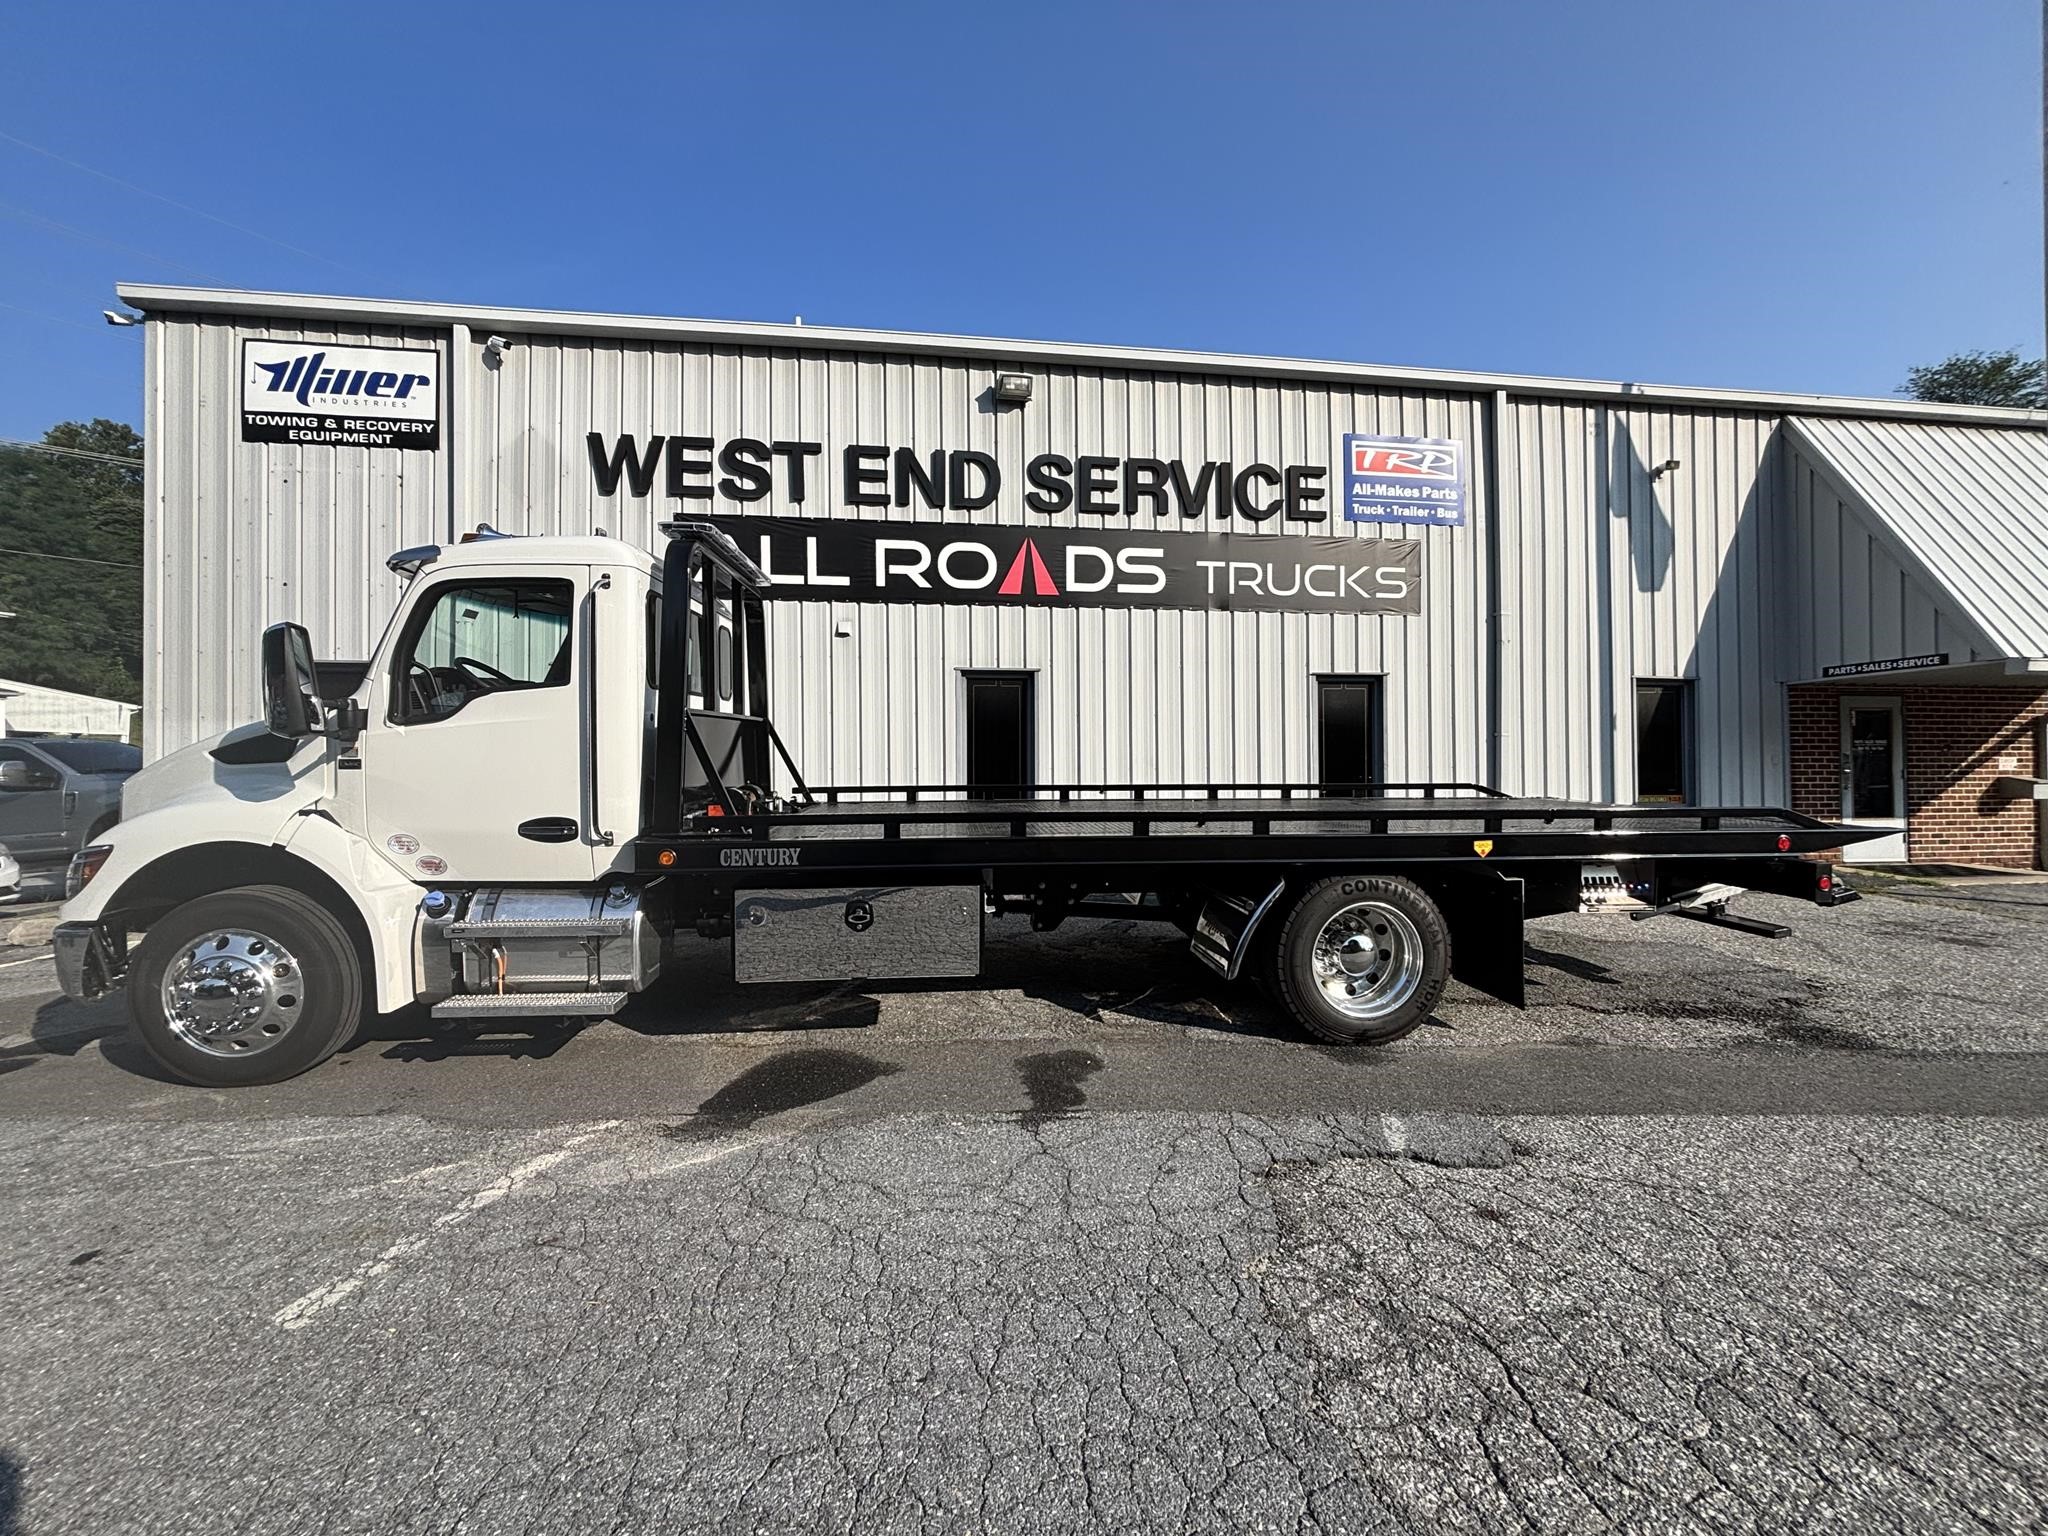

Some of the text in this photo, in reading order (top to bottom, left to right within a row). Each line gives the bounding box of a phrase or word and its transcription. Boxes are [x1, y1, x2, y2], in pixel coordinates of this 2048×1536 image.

[254, 351, 431, 407] Miller
[312, 396, 407, 408] INDUSTRIES
[245, 414, 435, 433] TOWING & RECOVERY
[289, 429, 393, 444] EQUIPMENT
[1354, 447, 1455, 477] TRP
[586, 431, 1328, 523] WEST END SERVICE
[1352, 483, 1458, 500] All-Makes Parts
[1352, 503, 1458, 519] Truck Trailer Bus
[875, 537, 1167, 596] ROADS
[1196, 560, 1408, 598] TRUCKS
[1828, 656, 1940, 676] PARTS SALES SERVICE
[720, 847, 801, 867] CENTURY
